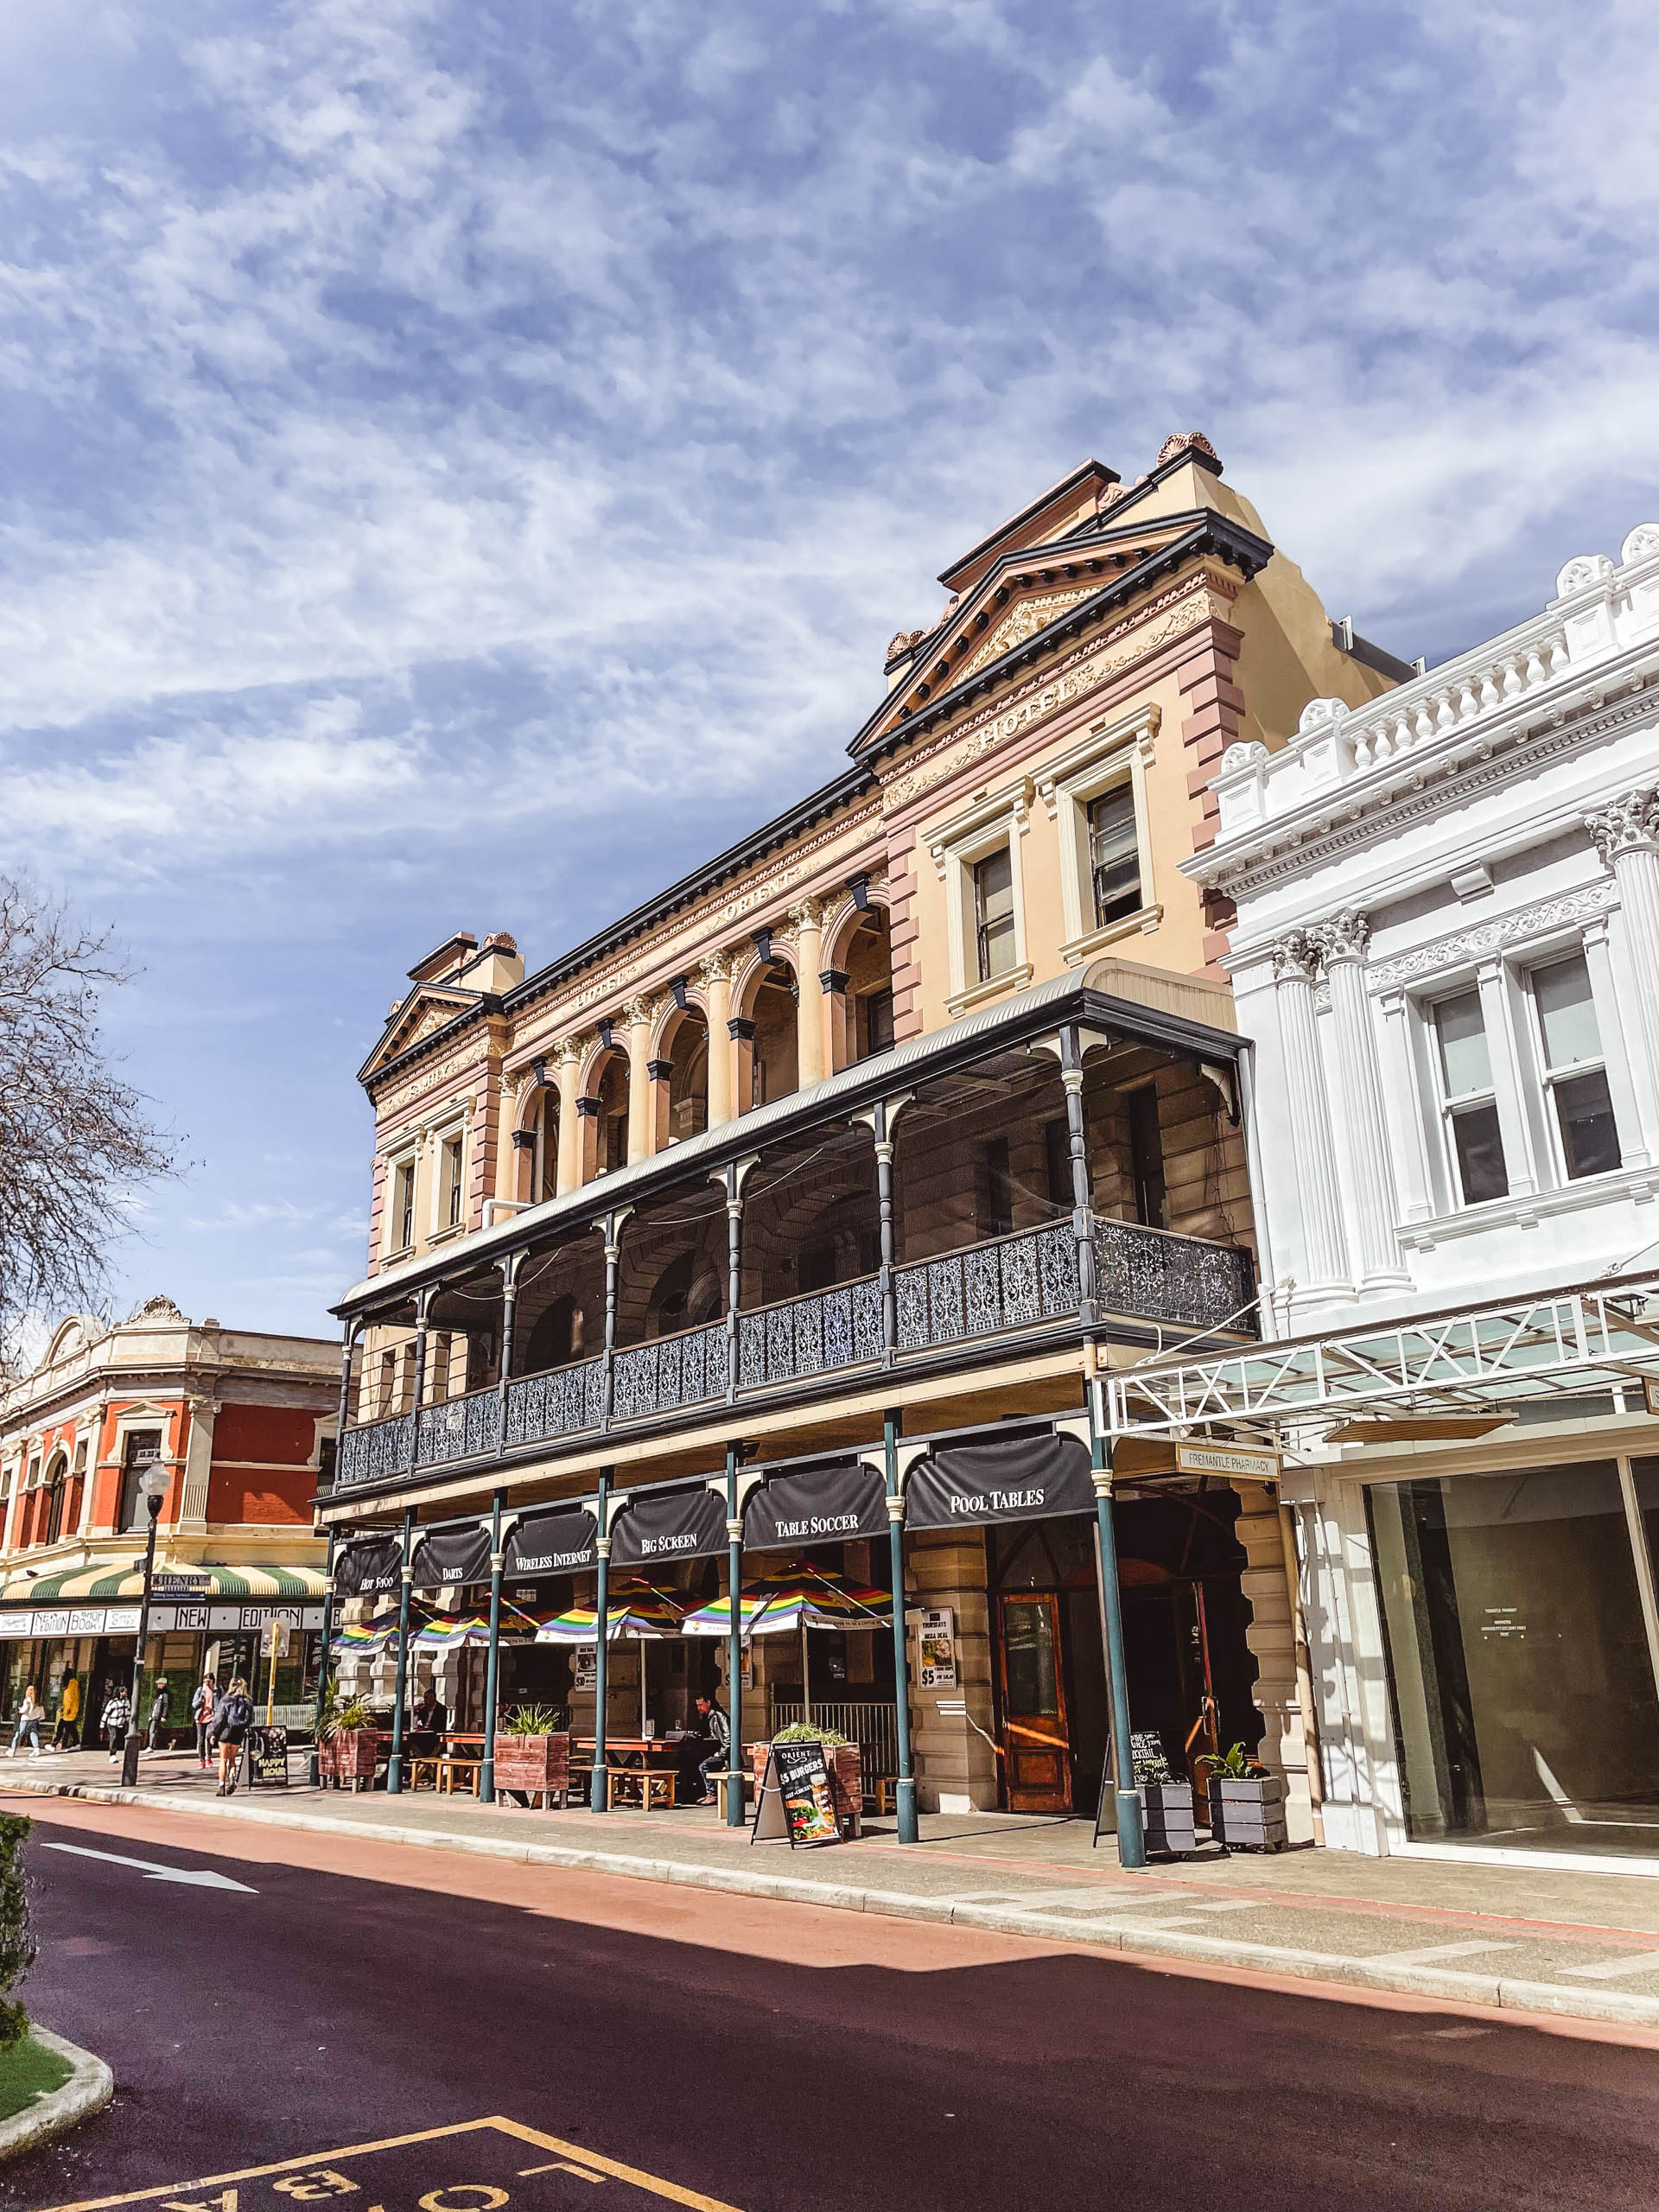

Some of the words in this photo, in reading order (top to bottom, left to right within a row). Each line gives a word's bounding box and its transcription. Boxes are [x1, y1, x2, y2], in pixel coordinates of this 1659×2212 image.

[980, 683, 1077, 753] HOTEL
[725, 869, 796, 920] ORIENT
[1189, 1453, 1230, 1468] FREMANTLE
[1231, 1458, 1269, 1471] PHARMACY
[950, 1494, 989, 1514] POOL
[990, 1488, 1046, 1510] TABLES
[775, 1519, 810, 1537] TABLE
[810, 1514, 859, 1535] SOCCER
[641, 1538, 657, 1554] BIG
[658, 1533, 697, 1552] SCREEN
[516, 1556, 552, 1572] WIRELESS
[553, 1549, 591, 1567] INTERNET
[162, 1575, 200, 1586] HENRY
[442, 1567, 463, 1580] DARTS
[359, 1578, 375, 1590] HOT
[180, 1609, 207, 1627] NEW
[922, 1669, 934, 1687] $5
[258, 1758, 286, 1767] HAPPY
[781, 1750, 810, 1760] ORIENT
[1132, 1748, 1159, 1760] OCKTAIL
[263, 1768, 286, 1777] HOUR
[779, 1772, 790, 1785] $5
[789, 1758, 823, 1781] BURGERS
